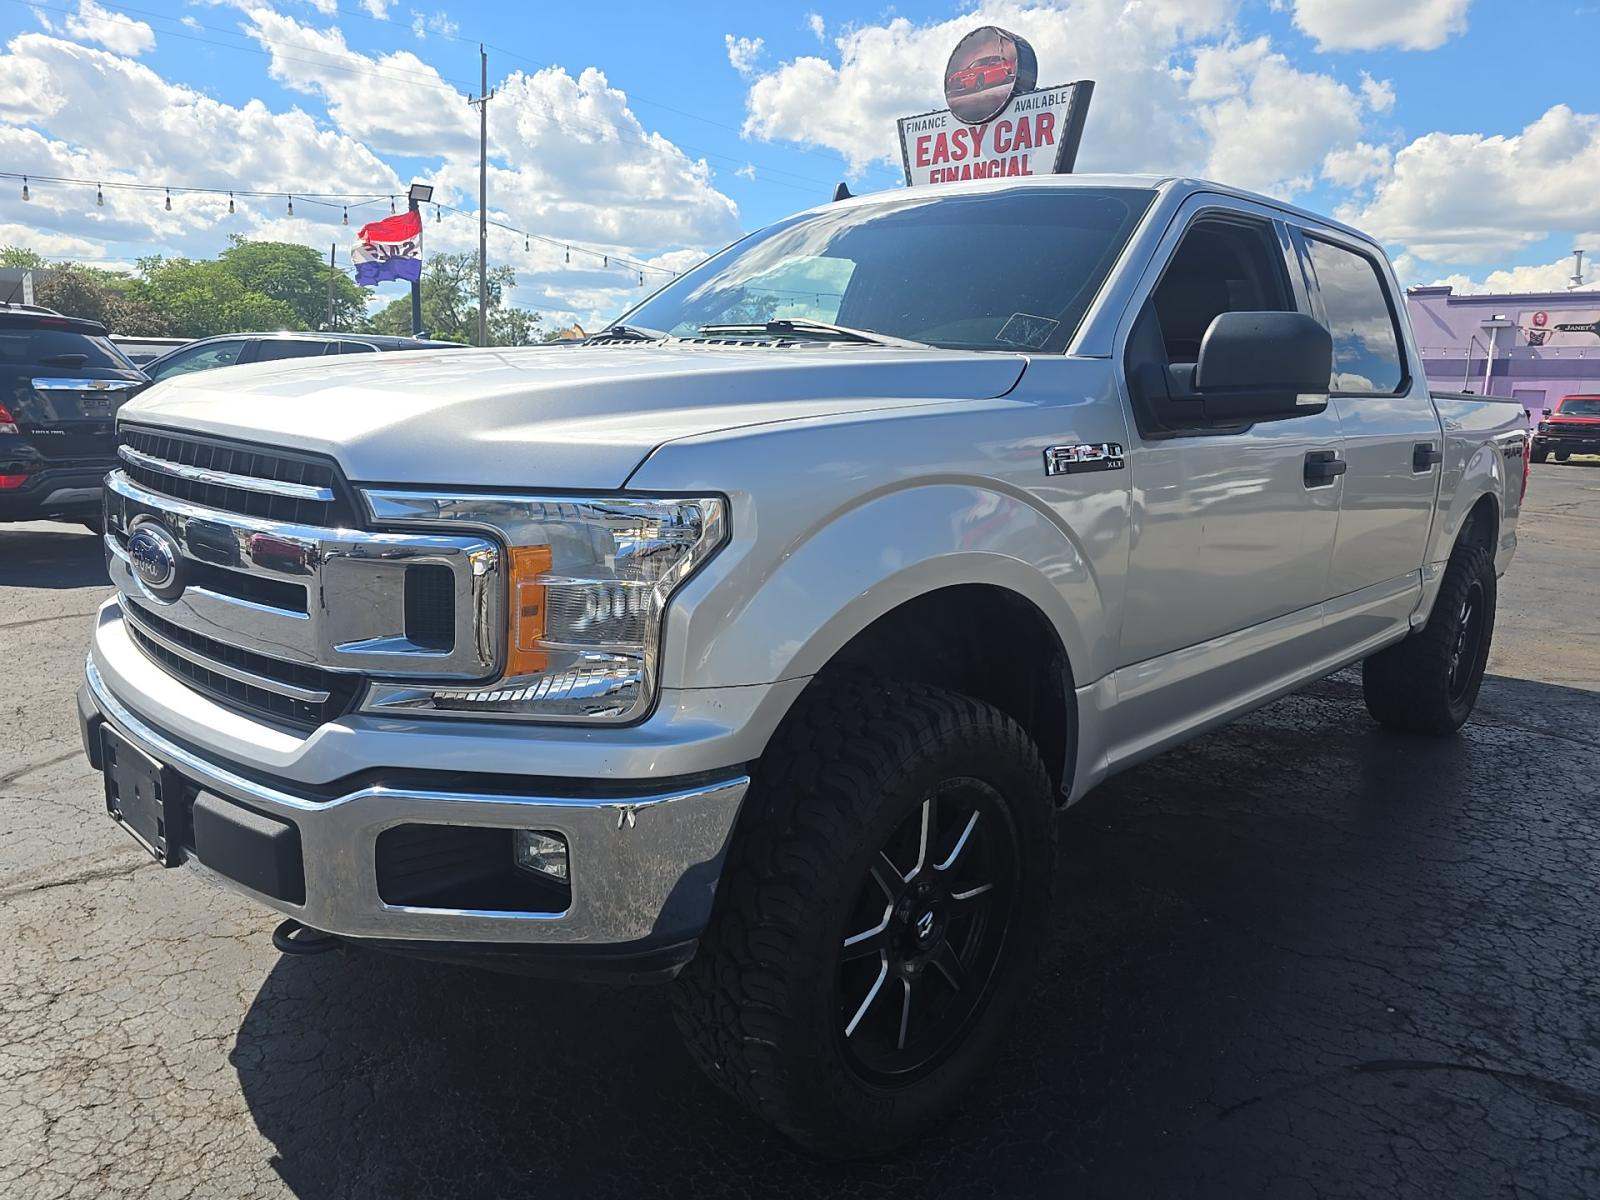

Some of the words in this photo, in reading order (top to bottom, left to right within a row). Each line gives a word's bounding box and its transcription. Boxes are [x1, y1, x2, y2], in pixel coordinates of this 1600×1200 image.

[906, 116, 947, 134] FINANCE
[1014, 92, 1067, 112] AVAILABLE
[916, 124, 989, 168] EASY
[993, 111, 1055, 154] CAR
[930, 154, 1032, 184] FINANCIAL
[1106, 459, 1122, 469] XLT
